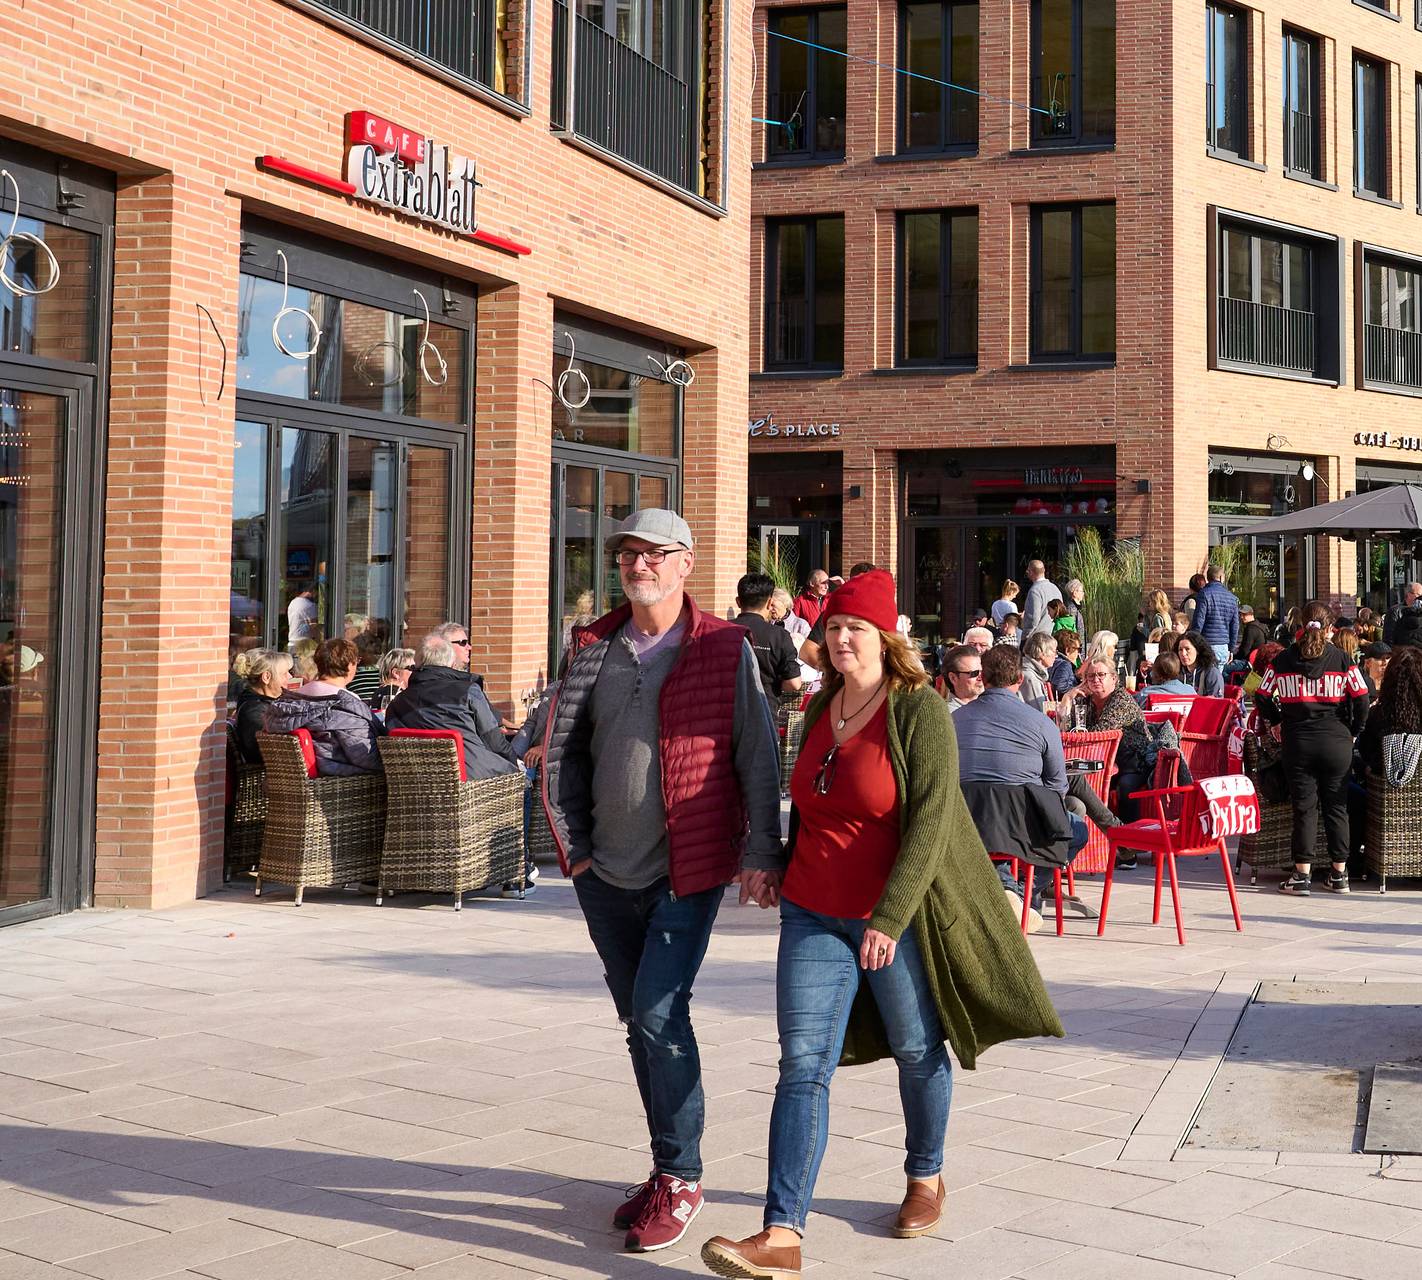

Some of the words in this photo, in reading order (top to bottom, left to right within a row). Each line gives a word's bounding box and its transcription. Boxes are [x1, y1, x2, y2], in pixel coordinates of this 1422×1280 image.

[365, 118, 426, 157] CAFE
[362, 136, 483, 232] extrablatt
[785, 423, 840, 436] PLACE
